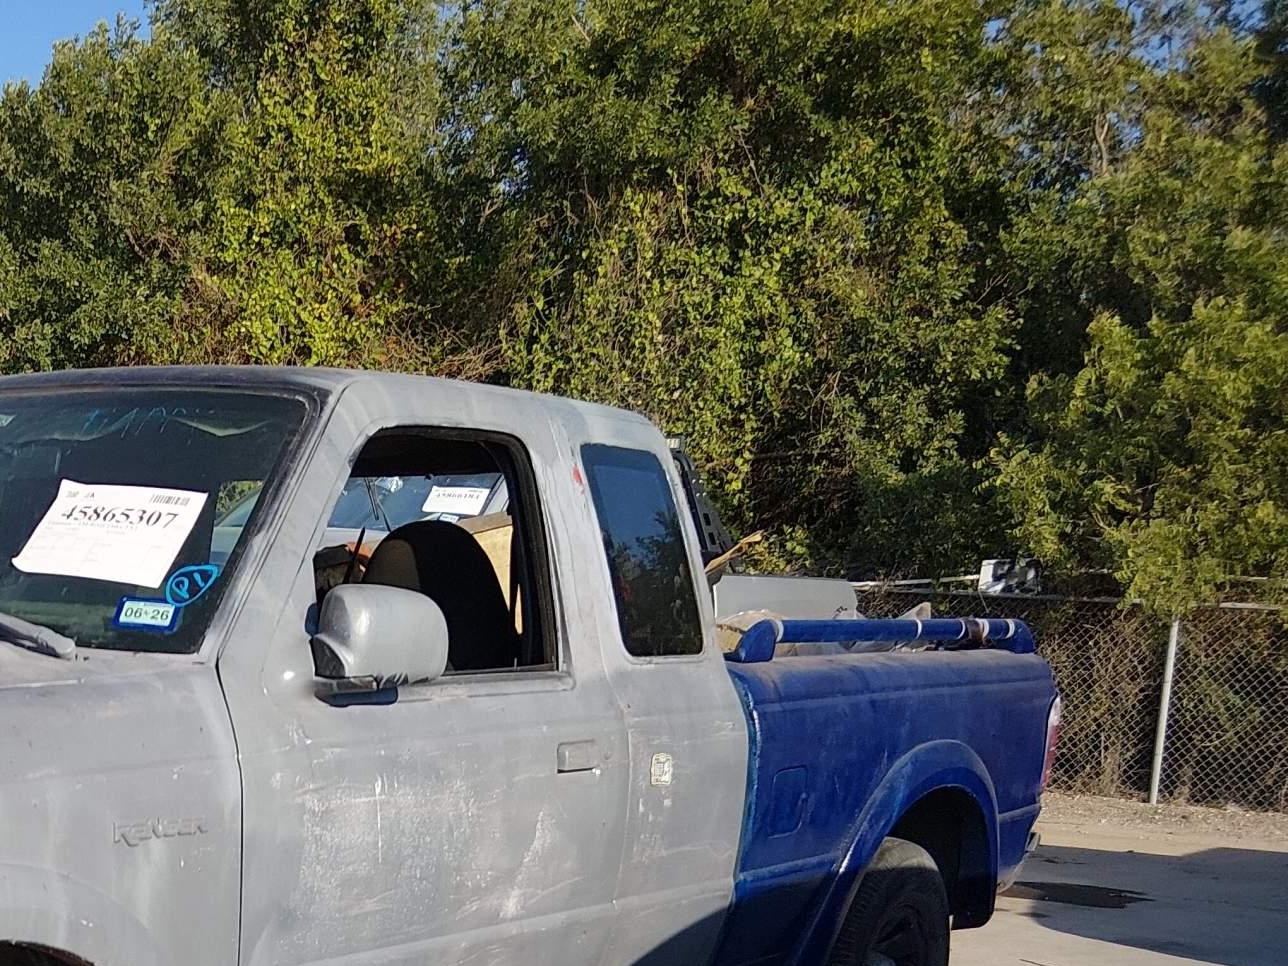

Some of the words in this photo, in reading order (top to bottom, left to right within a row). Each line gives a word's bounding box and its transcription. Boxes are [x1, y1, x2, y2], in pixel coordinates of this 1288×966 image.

[61, 504, 180, 529] 45865307
[124, 607, 144, 618] 06
[149, 609, 170, 621] 26
